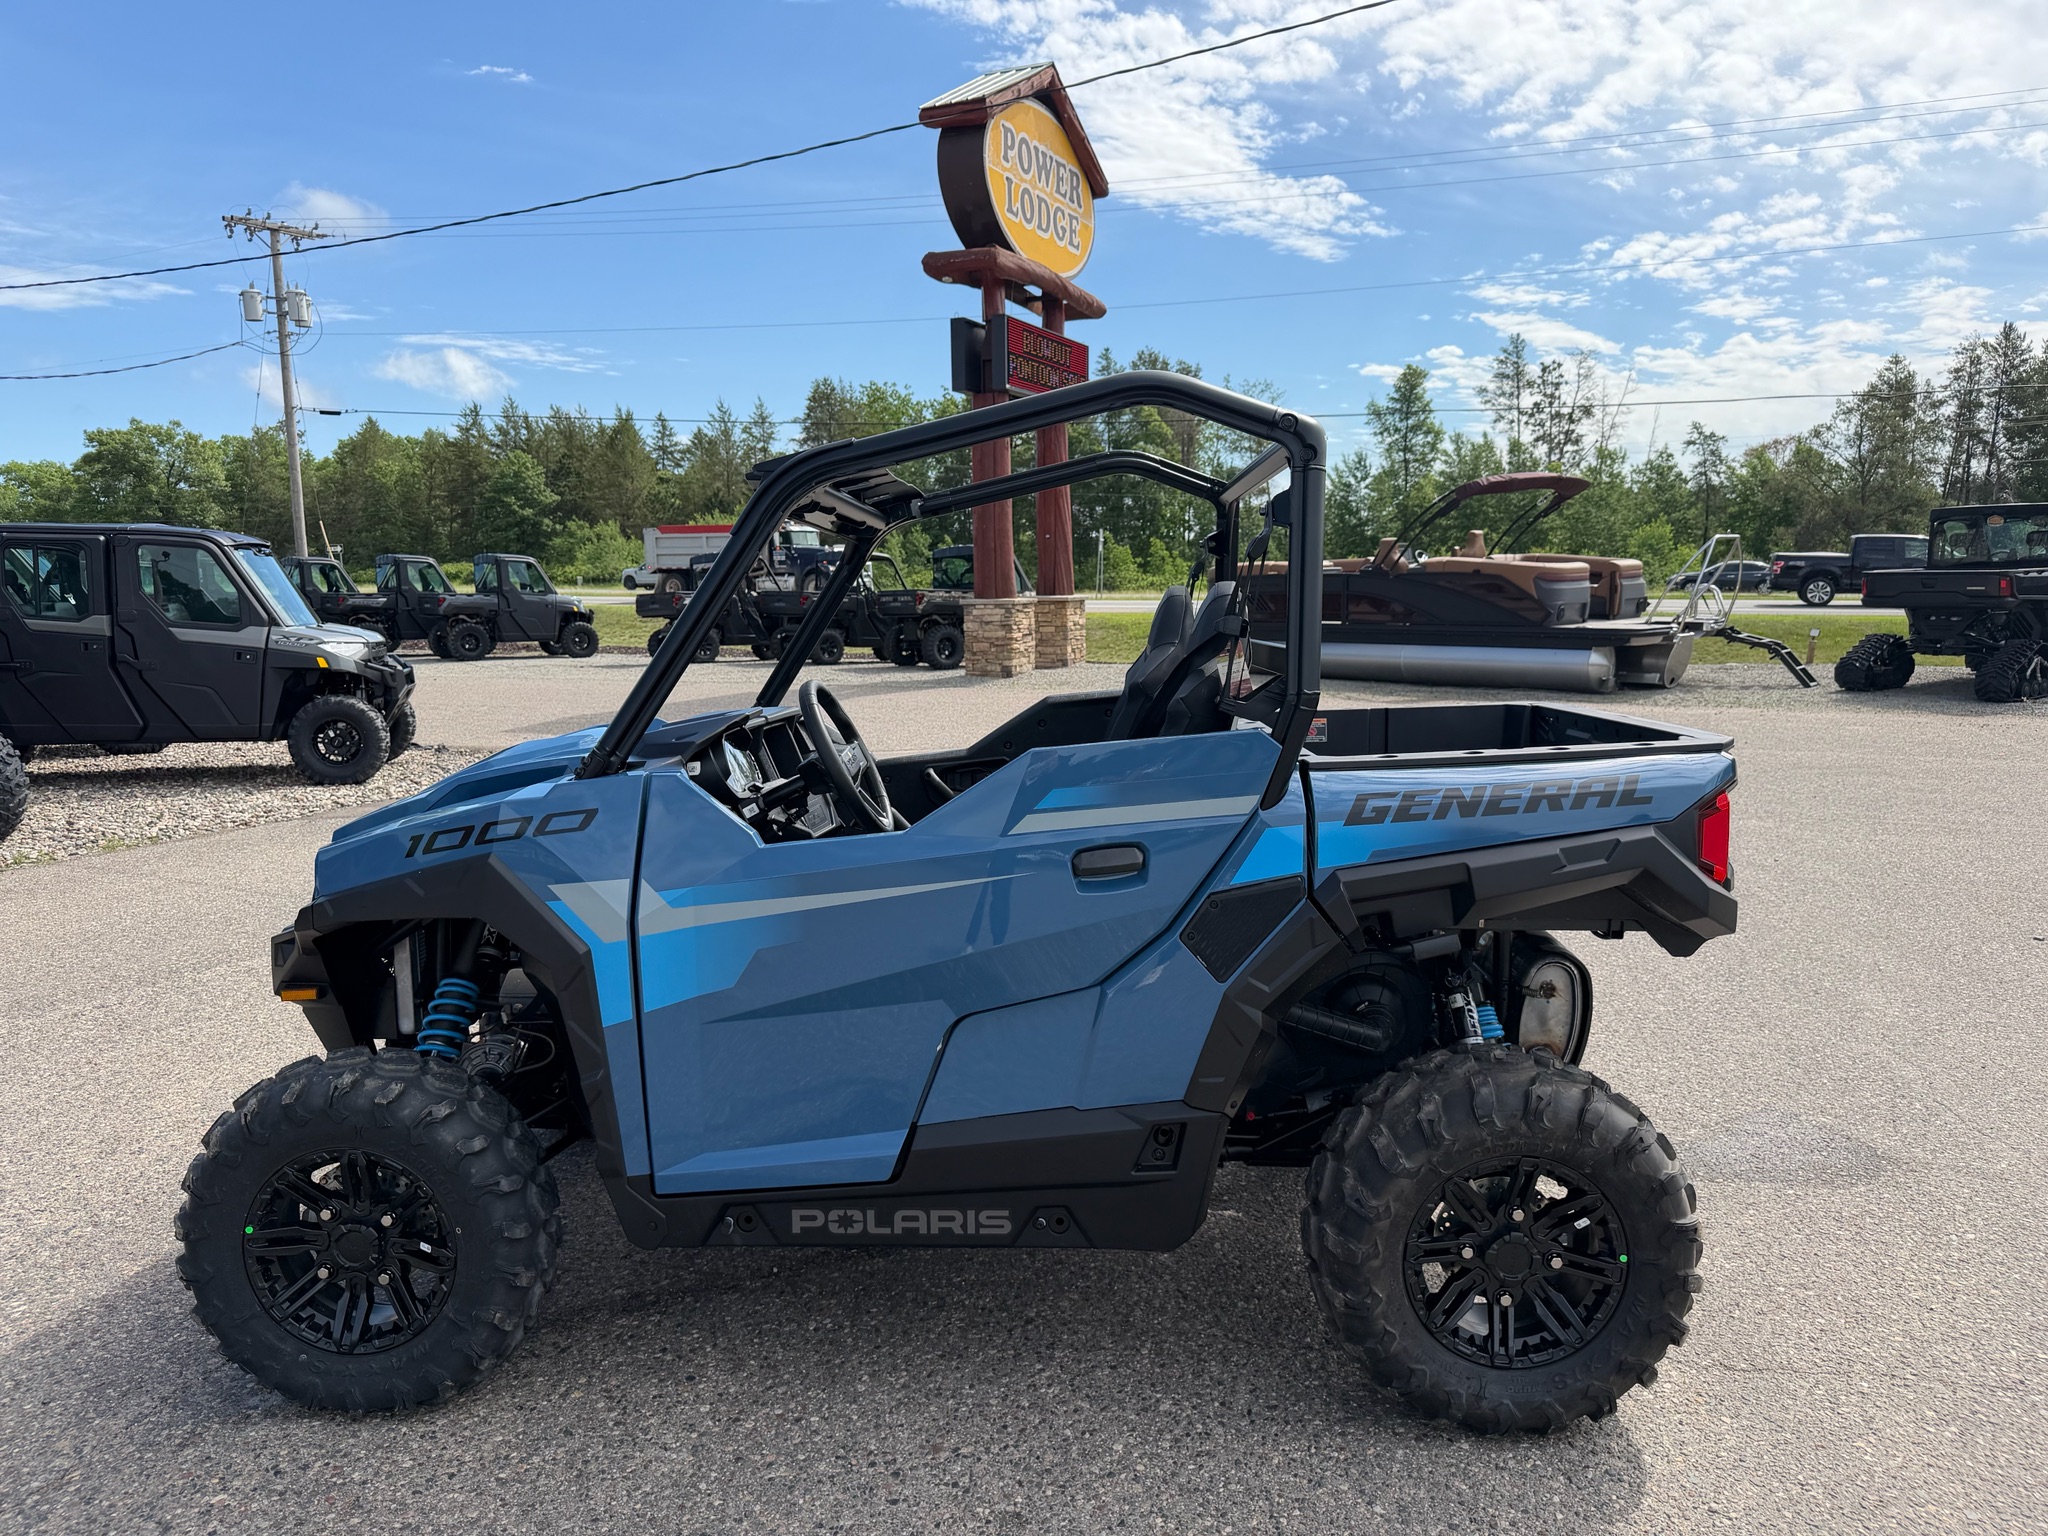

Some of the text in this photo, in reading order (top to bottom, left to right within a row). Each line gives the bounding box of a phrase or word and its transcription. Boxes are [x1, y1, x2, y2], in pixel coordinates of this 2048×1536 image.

[1001, 121, 1083, 210] POWER
[1004, 174, 1080, 253] LODGE
[1009, 354, 1060, 388] PONTOON
[1022, 330, 1072, 367] BLOWOUT
[1343, 774, 1654, 827] GENERAL
[404, 808, 599, 858] 1000
[791, 1208, 1013, 1235] POLARIS
